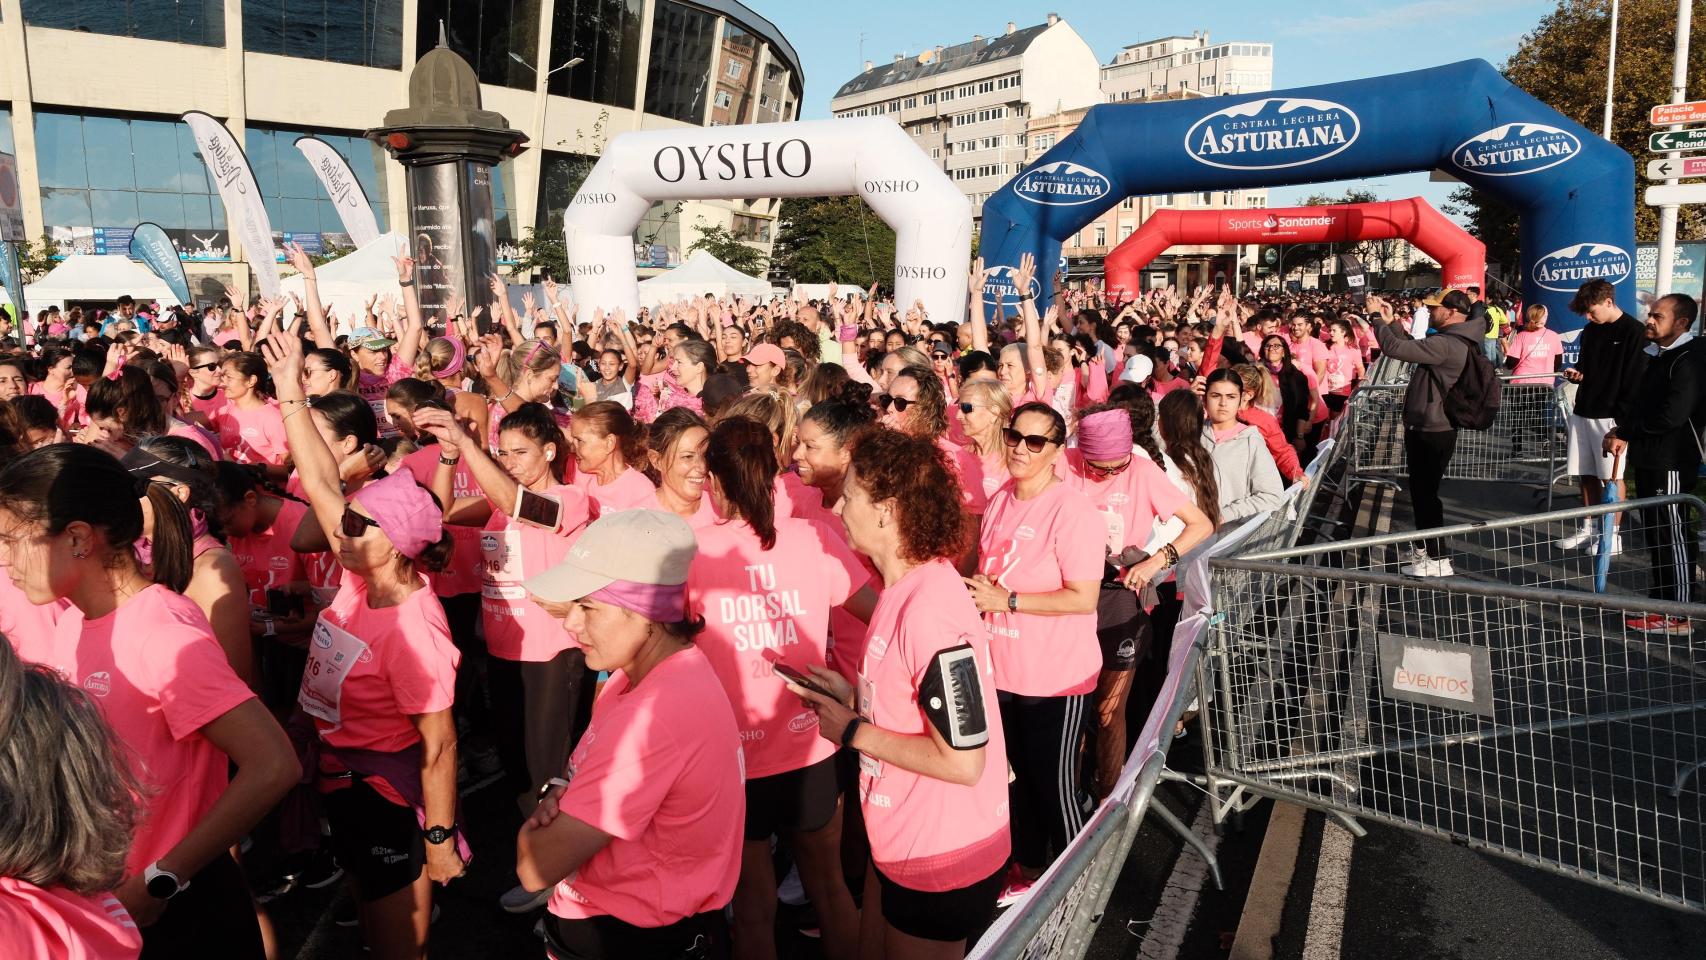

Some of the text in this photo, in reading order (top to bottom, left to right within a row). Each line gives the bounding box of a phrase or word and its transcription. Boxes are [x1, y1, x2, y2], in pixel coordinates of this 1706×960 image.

[1657, 105, 1694, 115] Palacio
[1672, 113, 1687, 121] los
[1223, 112, 1341, 131] CENTRAL LECHERA
[1197, 123, 1347, 156] ASTURIANA
[1478, 134, 1567, 152] CENTRAL LECHERA
[653, 138, 813, 183] OYSHO
[1462, 141, 1573, 168] ASTURIANA
[864, 179, 919, 194] OYSHO
[1018, 176, 1102, 196] ASTURIANA
[575, 192, 616, 205] OYSHO
[1228, 216, 1337, 231] Sports Santander
[1552, 255, 1625, 267] CENTRAL LECHERA
[896, 264, 946, 279] OYSHO
[1537, 262, 1627, 282] ASTURIANA
[744, 562, 776, 592] TU
[719, 589, 808, 625] DORSAL
[733, 618, 800, 652] SUMA
[1396, 669, 1469, 695] EVENTOS
